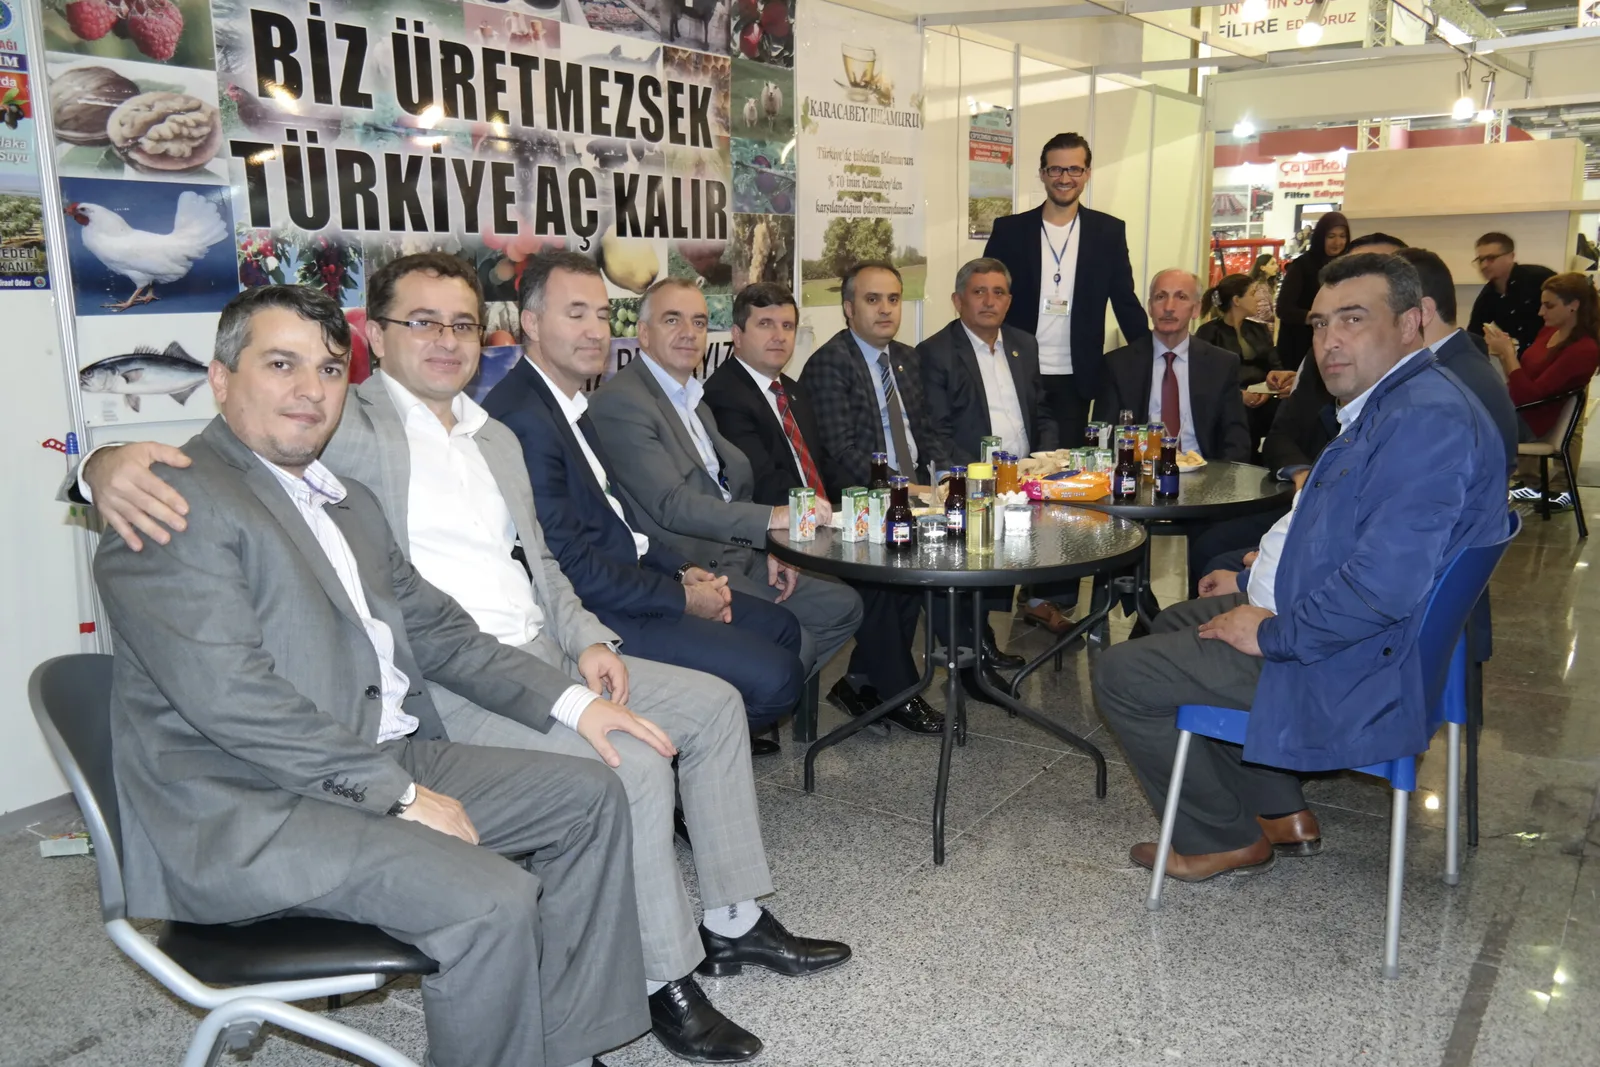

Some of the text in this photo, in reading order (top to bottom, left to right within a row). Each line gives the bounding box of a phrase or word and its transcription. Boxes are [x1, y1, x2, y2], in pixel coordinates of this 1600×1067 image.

[249, 1, 714, 149] BİZ ÜRETMEZSEK
[810, 98, 868, 123] KARACABEY
[229, 129, 728, 250] TÜRKİYE AÇ KALIR
[1284, 191, 1310, 199] Filtre
